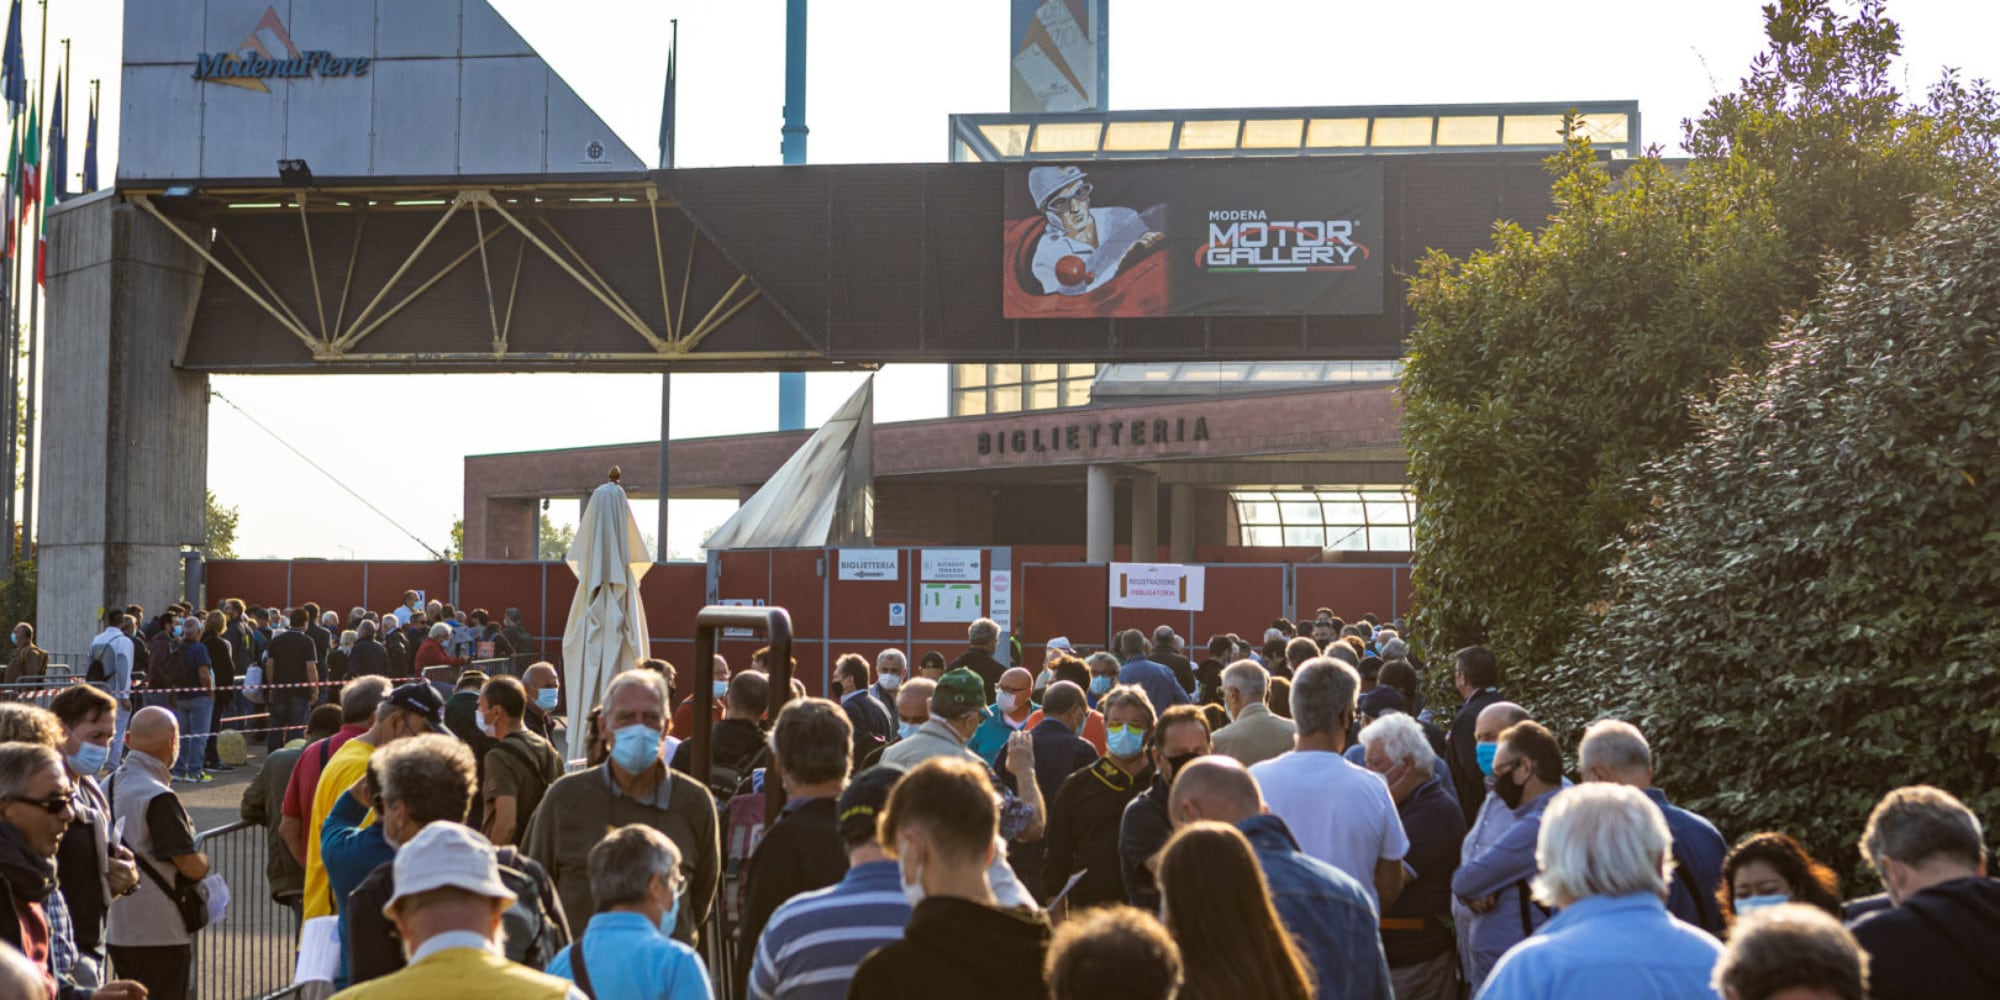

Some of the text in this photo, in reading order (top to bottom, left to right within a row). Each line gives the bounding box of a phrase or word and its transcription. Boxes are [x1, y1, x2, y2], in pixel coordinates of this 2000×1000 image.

[191, 50, 369, 81] ModenaFiere
[1209, 211, 1267, 221] MODENA
[1209, 221, 1353, 248] MOTOR
[1207, 246, 1357, 265] GALLERY
[977, 416, 1209, 456] BIGLIETTERIA
[841, 561, 896, 569] BIGLIETTERIA
[1129, 578, 1176, 586] REGISTRAZIONE
